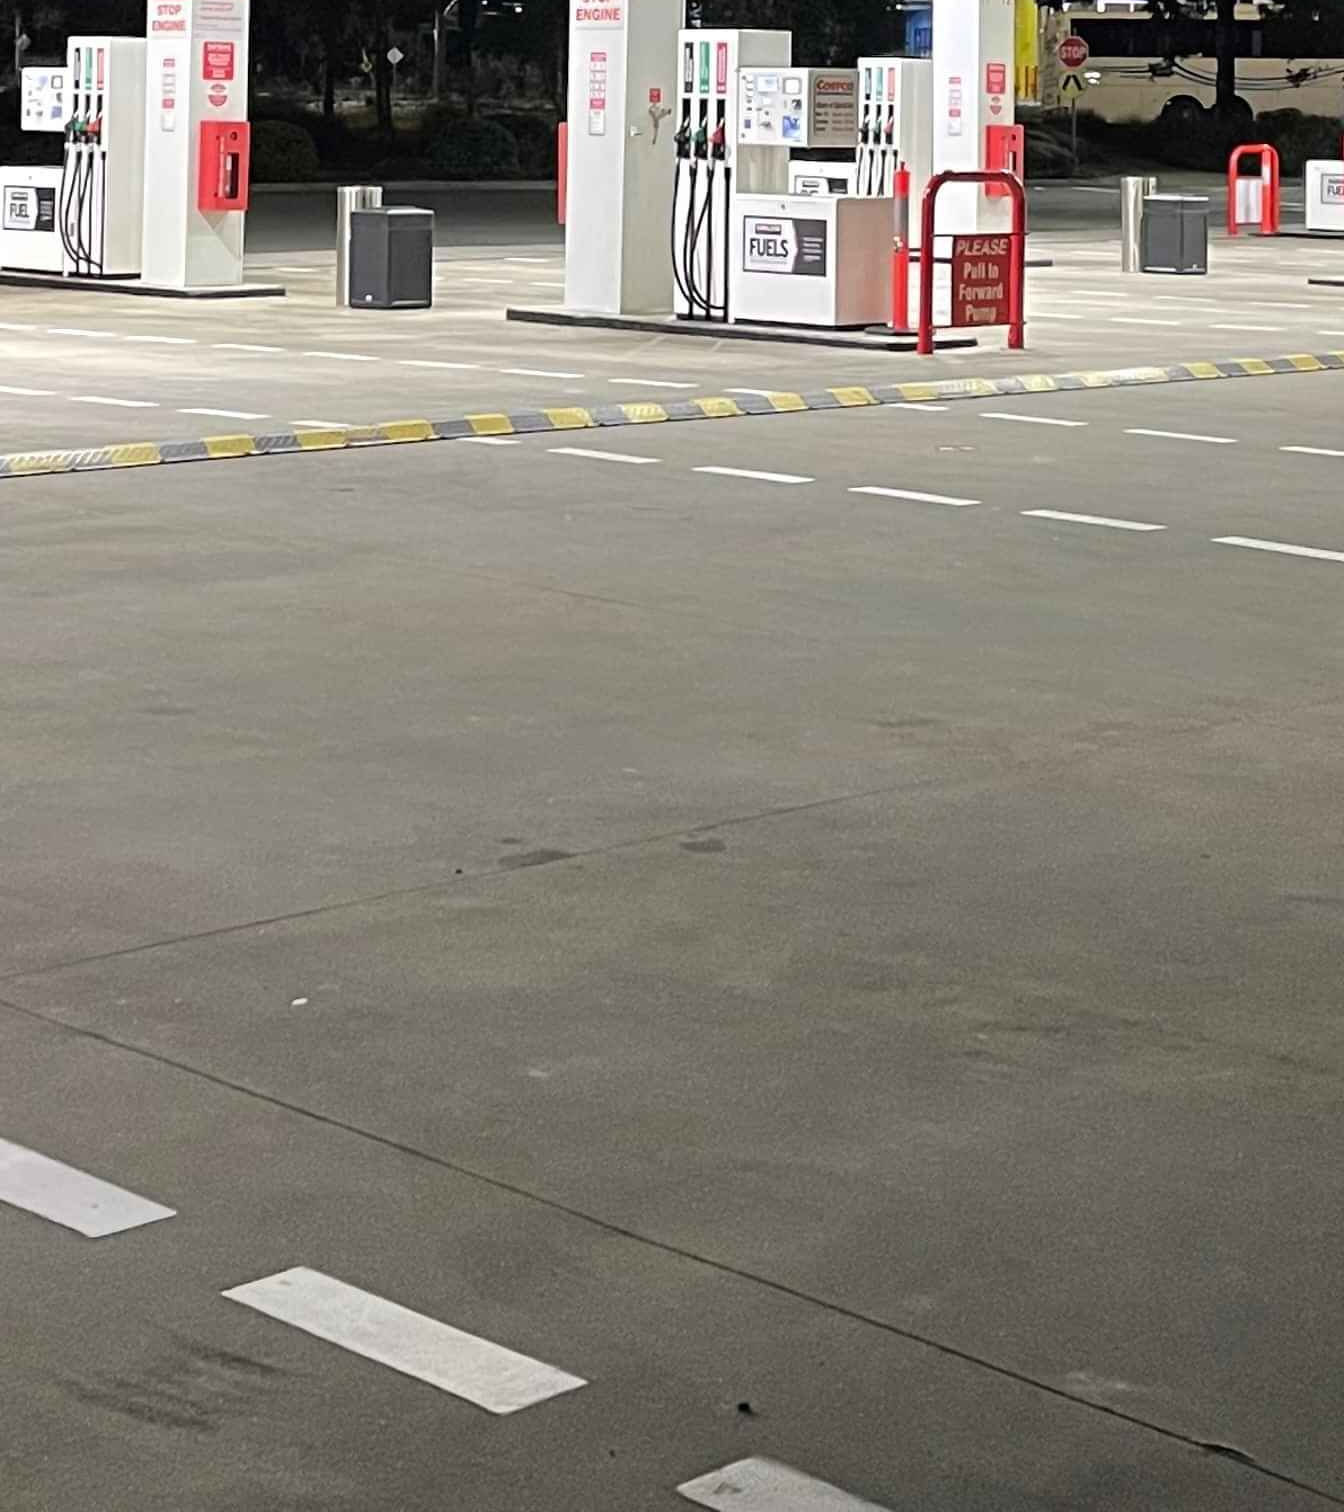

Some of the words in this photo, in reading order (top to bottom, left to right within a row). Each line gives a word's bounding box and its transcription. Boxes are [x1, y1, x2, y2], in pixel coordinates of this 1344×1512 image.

[157, 4, 182, 16] STOP
[576, 7, 621, 21] ENGINE
[152, 20, 186, 31] ENGINE
[1059, 45, 1088, 59] STOP
[750, 238, 788, 258] FUELS
[957, 239, 1009, 256] PLEASE
[964, 262, 986, 279] Pull
[959, 282, 1004, 301] Forward
[966, 304, 997, 323] Pump
